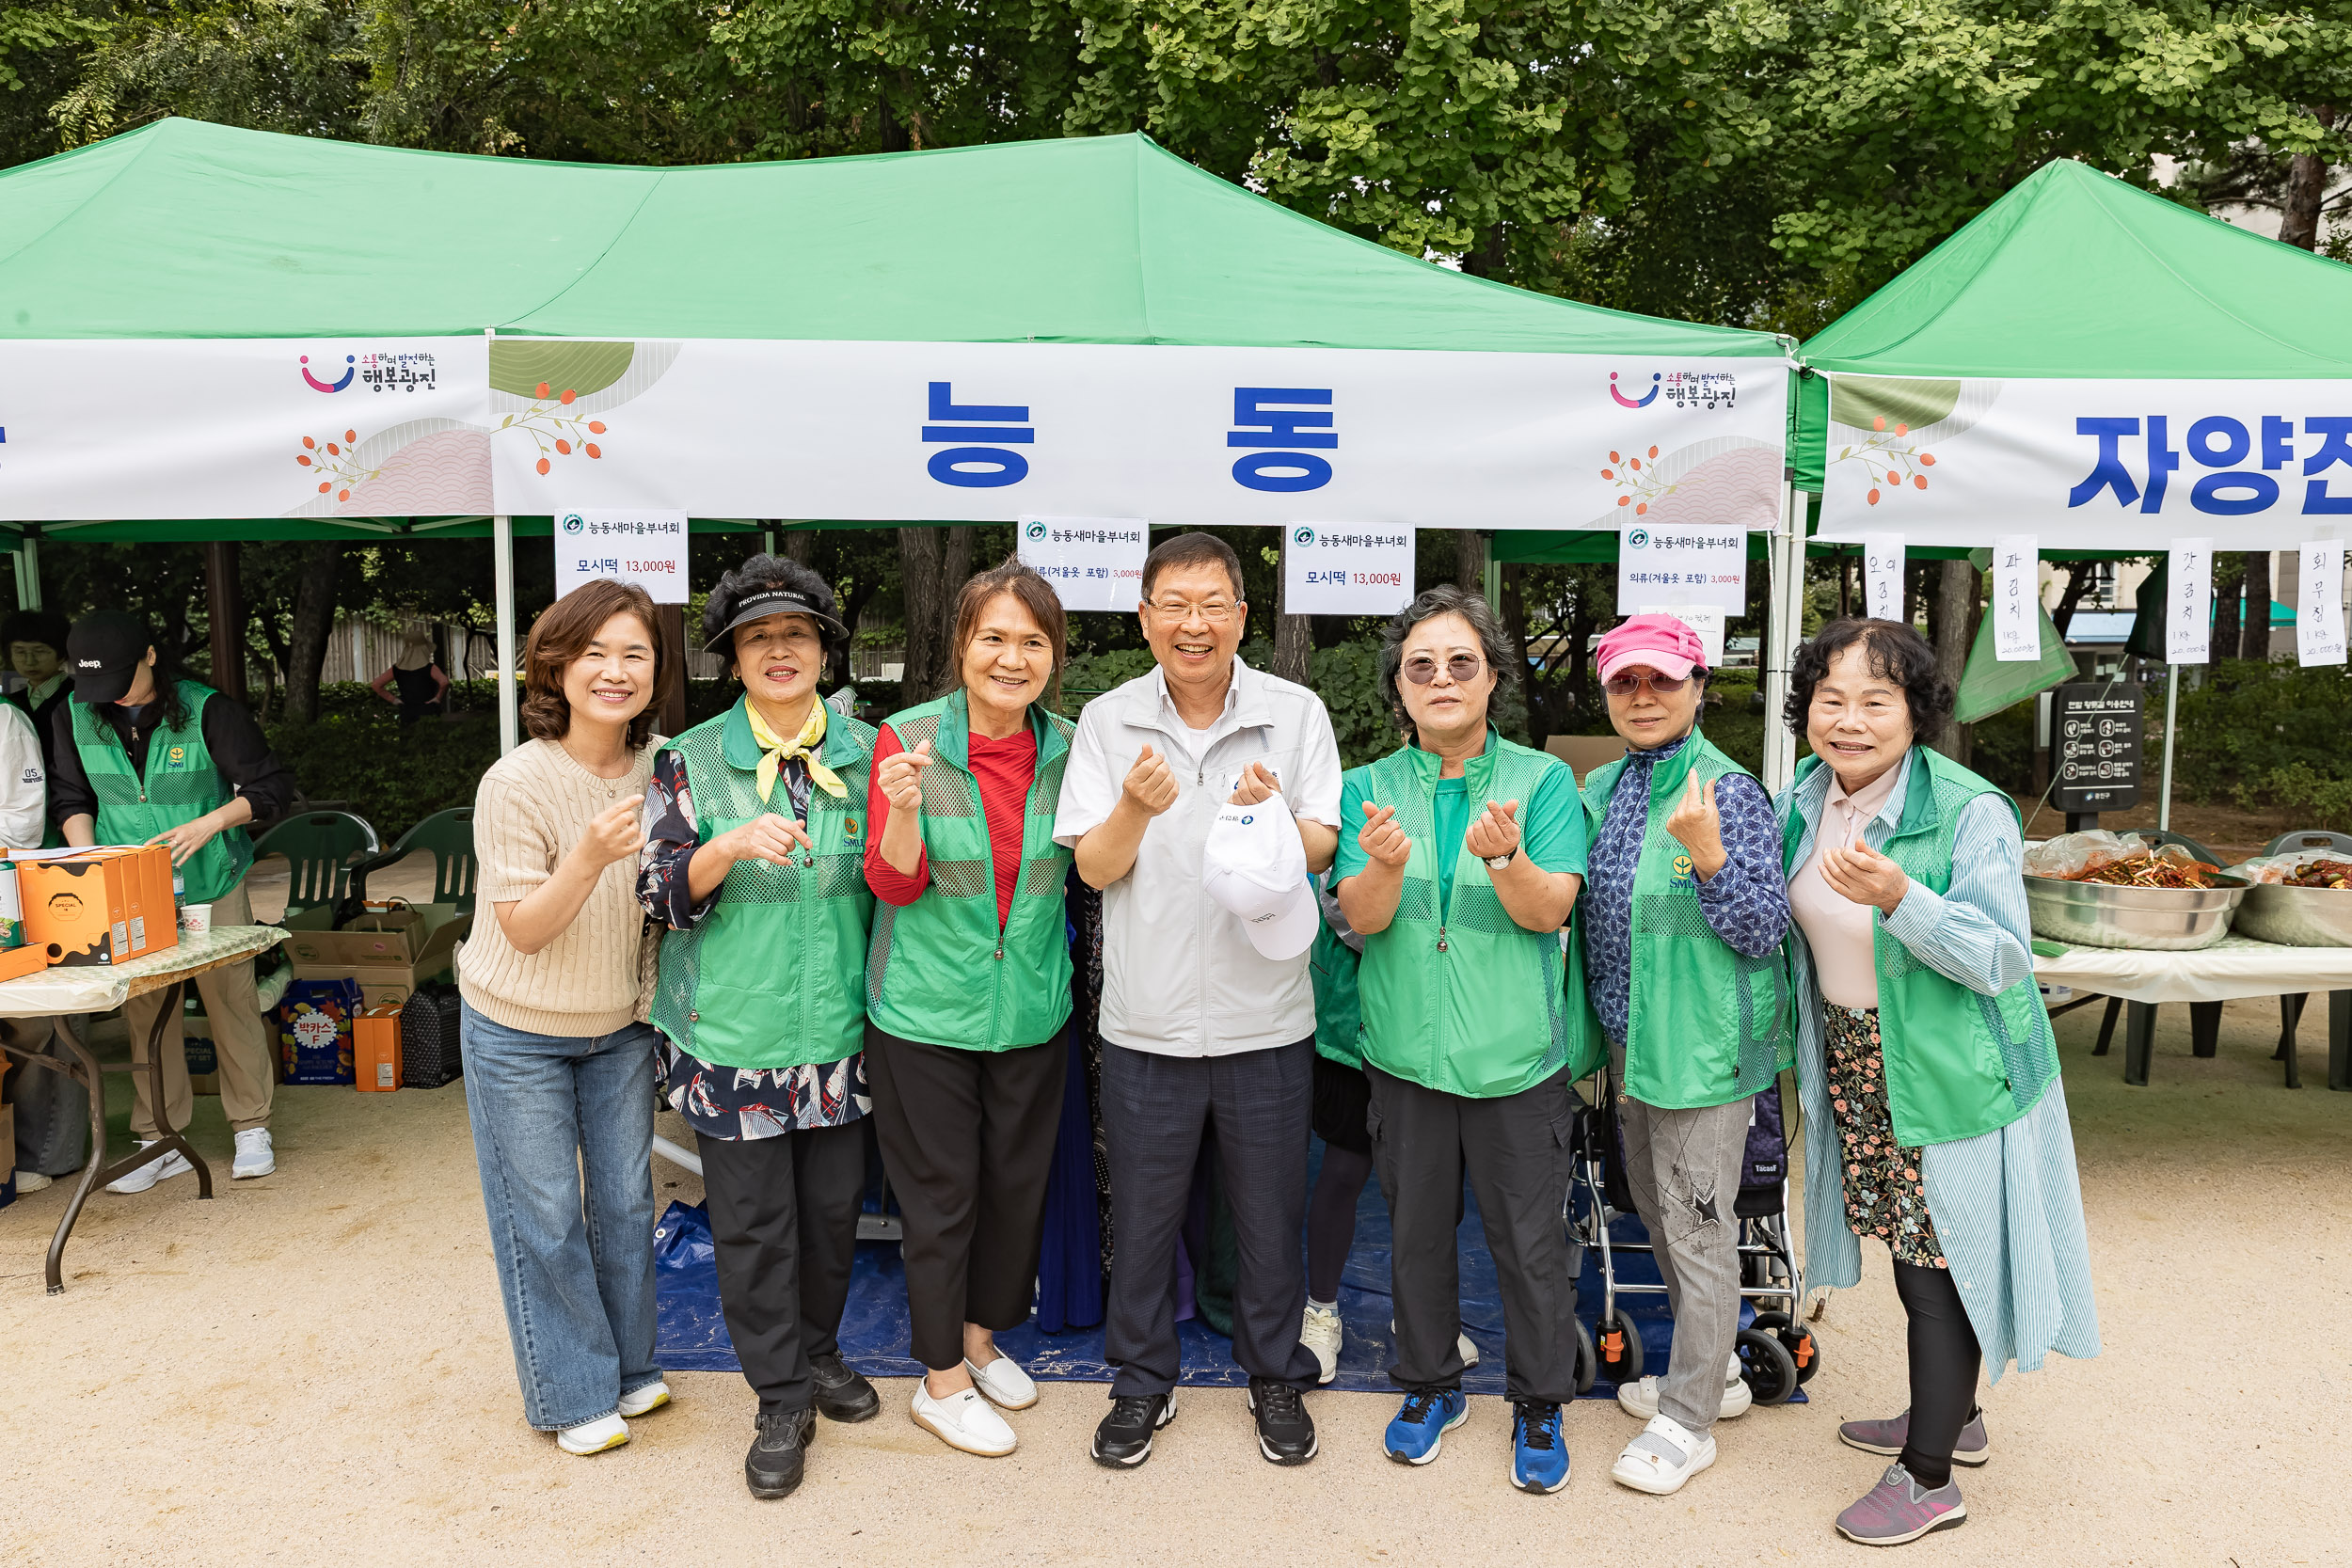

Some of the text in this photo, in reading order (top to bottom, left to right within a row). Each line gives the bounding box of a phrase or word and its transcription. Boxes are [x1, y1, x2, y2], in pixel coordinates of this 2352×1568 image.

[362, 353, 435, 369] 소통하며 발전하는
[362, 366, 436, 392] 행복광진
[1666, 372, 1736, 387] 소통하며 발전하는
[1666, 386, 1736, 409] 행복광진
[589, 521, 679, 534] 능동새마을부녀회
[1051, 529, 1140, 544] 능동새마을부녀회
[1319, 534, 1406, 547] 능동새마을부녀회
[1653, 536, 1739, 549] 능동새마을부녀회
[577, 558, 675, 574] 모시떡 13,000원
[1086, 567, 1108, 578] 포함)
[1113, 569, 1142, 579] 3,000원
[1306, 570, 1401, 586] 모시떡 13,000원
[1685, 573, 1707, 584] 포함)
[1710, 575, 1740, 584] 3,000원
[739, 591, 806, 608] PROVIDA NATURAL
[78, 658, 102, 669] Jeep
[843, 837, 864, 847] SMU
[299, 1022, 331, 1034] 박카스
[312, 1035, 320, 1044] F
